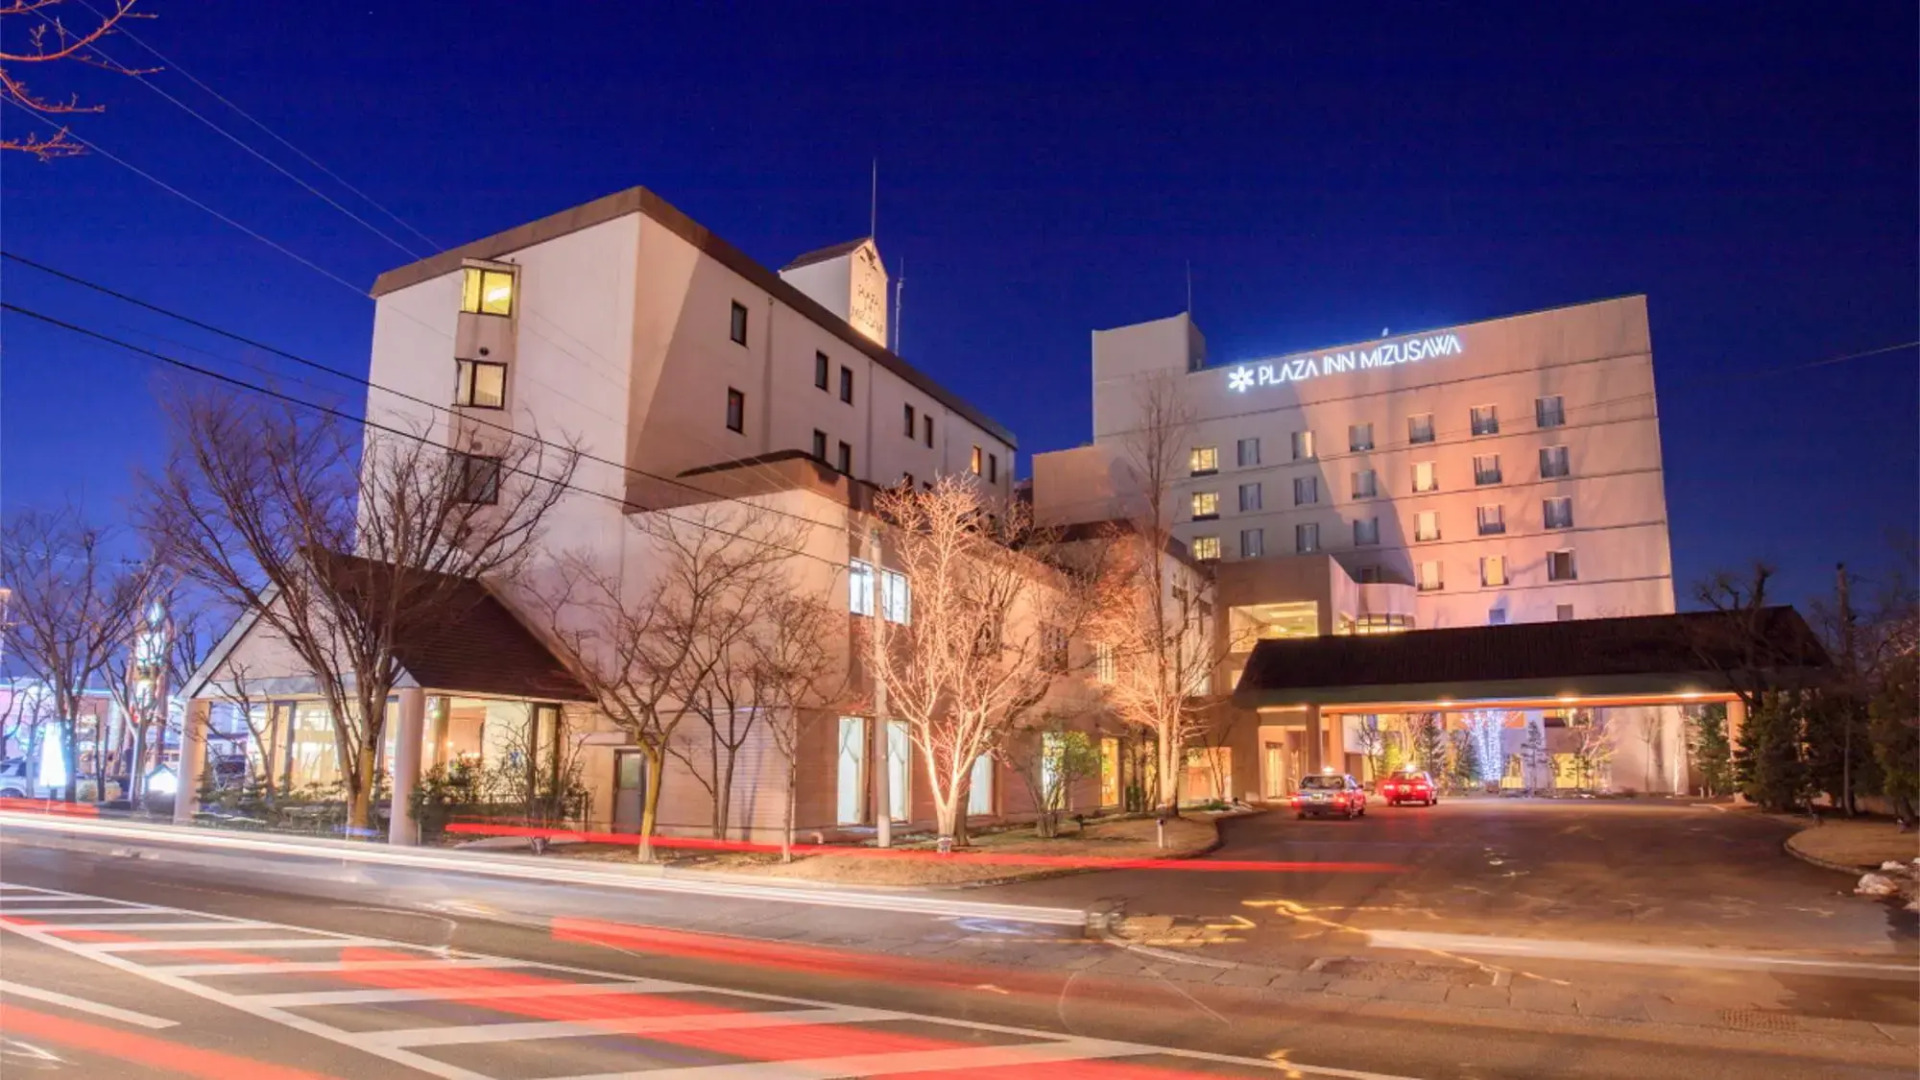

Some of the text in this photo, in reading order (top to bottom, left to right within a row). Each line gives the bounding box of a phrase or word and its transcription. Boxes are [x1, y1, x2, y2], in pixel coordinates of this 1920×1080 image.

[1258, 334, 1461, 386] PLAZA INN MIZUSAWA
